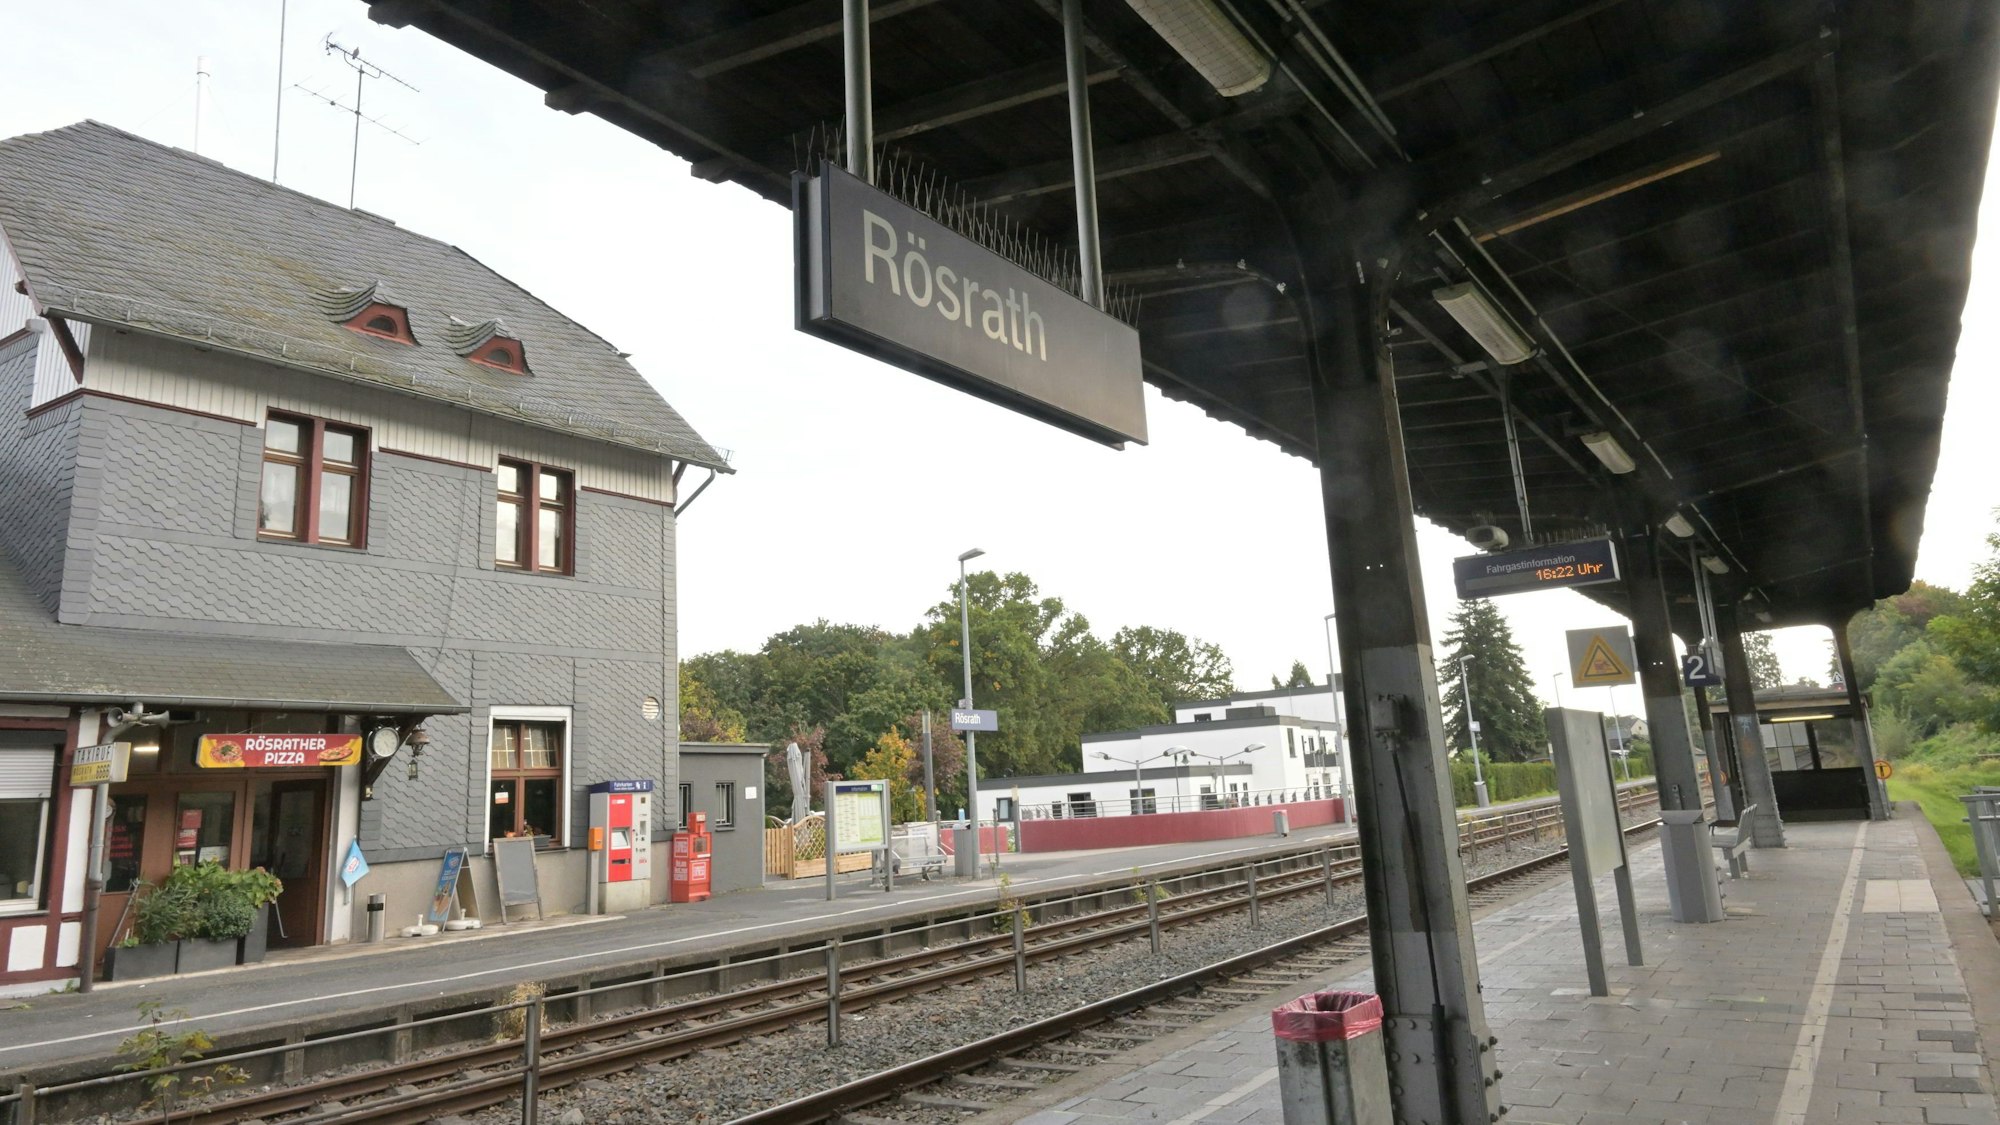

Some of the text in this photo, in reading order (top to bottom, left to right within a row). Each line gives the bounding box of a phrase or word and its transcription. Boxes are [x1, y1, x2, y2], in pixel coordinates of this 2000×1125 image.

[863, 209, 1047, 362] Rösrath
[1486, 554, 1576, 574] Fahrgastinformation
[1536, 563, 1603, 581] 16:22 Uhr
[1687, 655, 1706, 680] 2
[955, 712, 981, 724] Rösrath
[245, 735, 327, 751] RÖSRATHER
[264, 752, 305, 765] PIZZA
